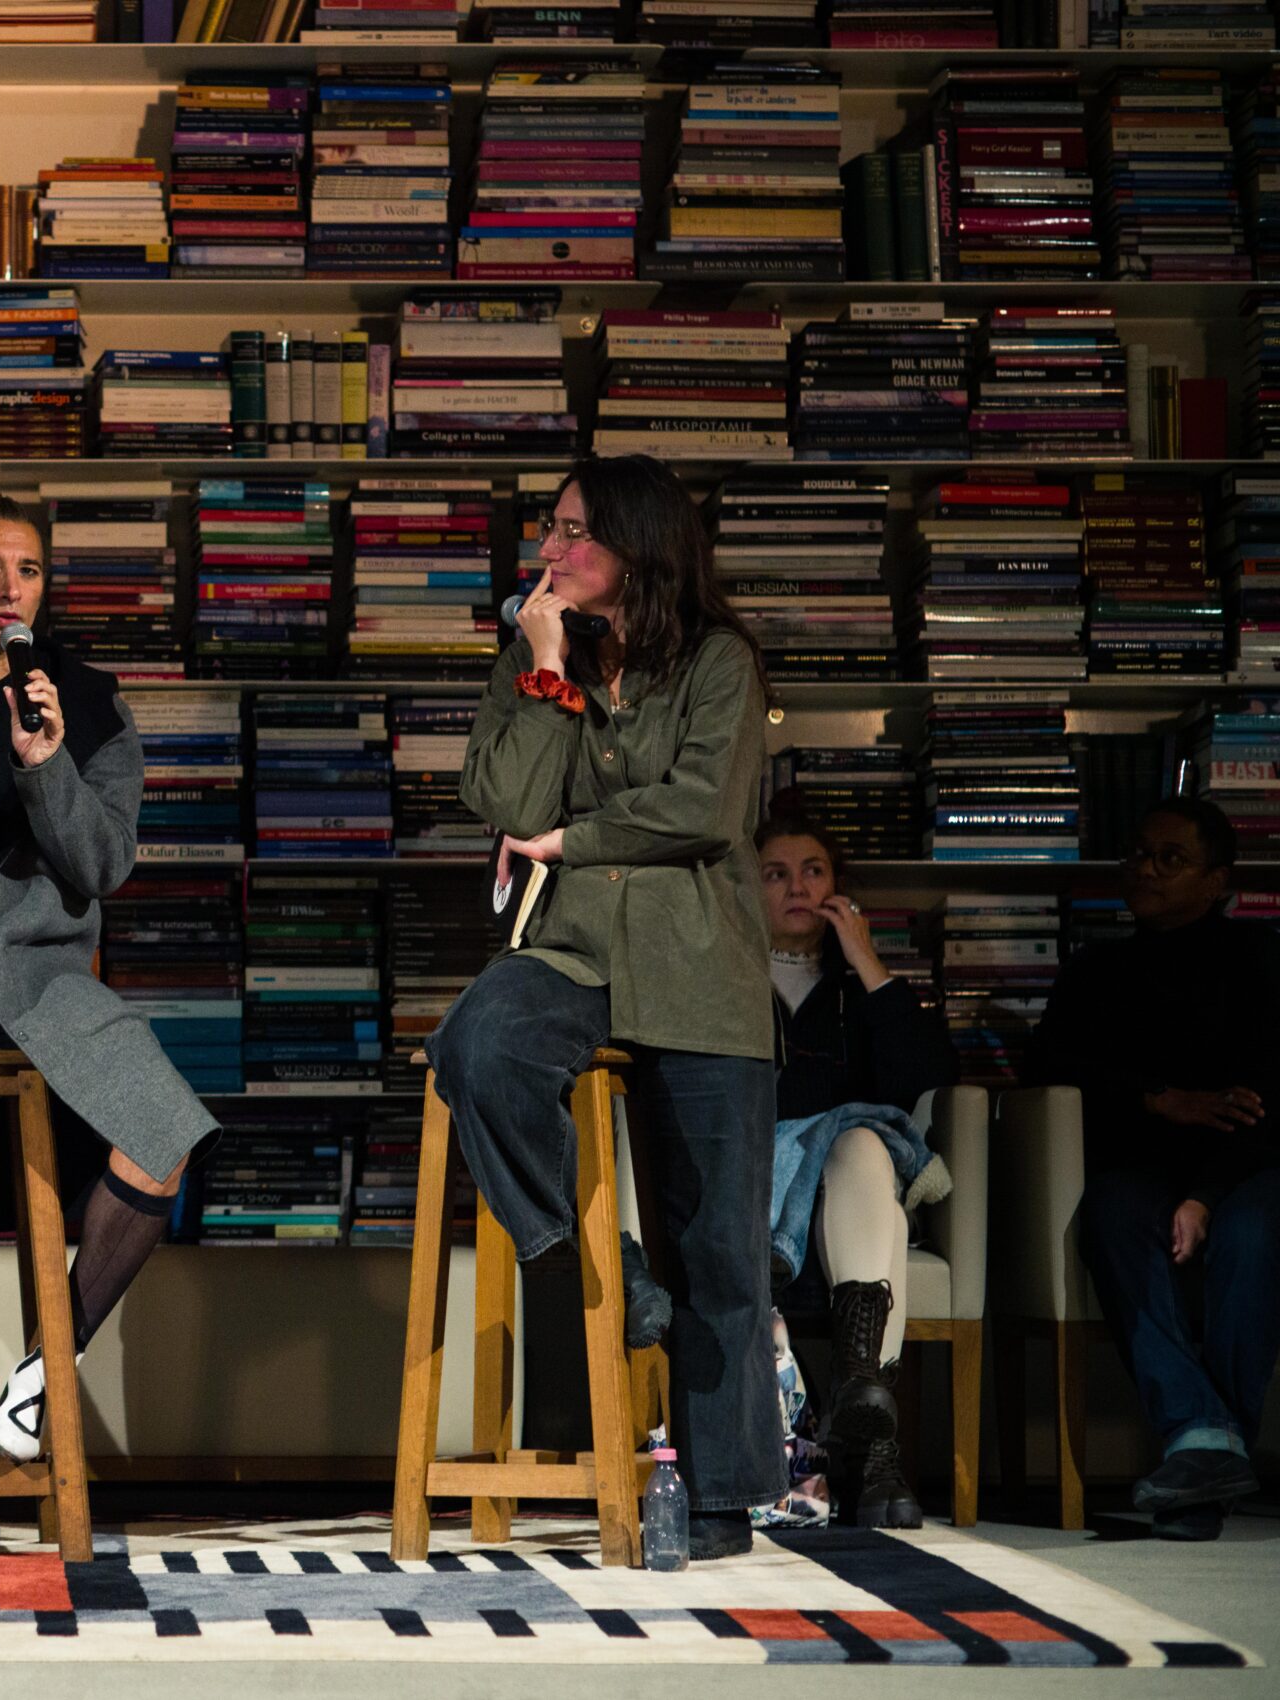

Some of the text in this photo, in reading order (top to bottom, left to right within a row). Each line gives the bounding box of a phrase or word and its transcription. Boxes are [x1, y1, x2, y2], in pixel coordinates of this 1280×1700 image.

[535, 11, 582, 21] BENN
[936, 129, 952, 237] SICKERT
[891, 357, 965, 369] PAUL NEWMAN
[893, 375, 959, 387] GRACE KELLY
[421, 431, 505, 443] Collage in Russia
[803, 480, 856, 489] KOUDELKA
[736, 583, 843, 594] RUSSIAN PARIS
[1211, 761, 1269, 779] LEAST
[140, 847, 224, 857] Olafur Eliasson
